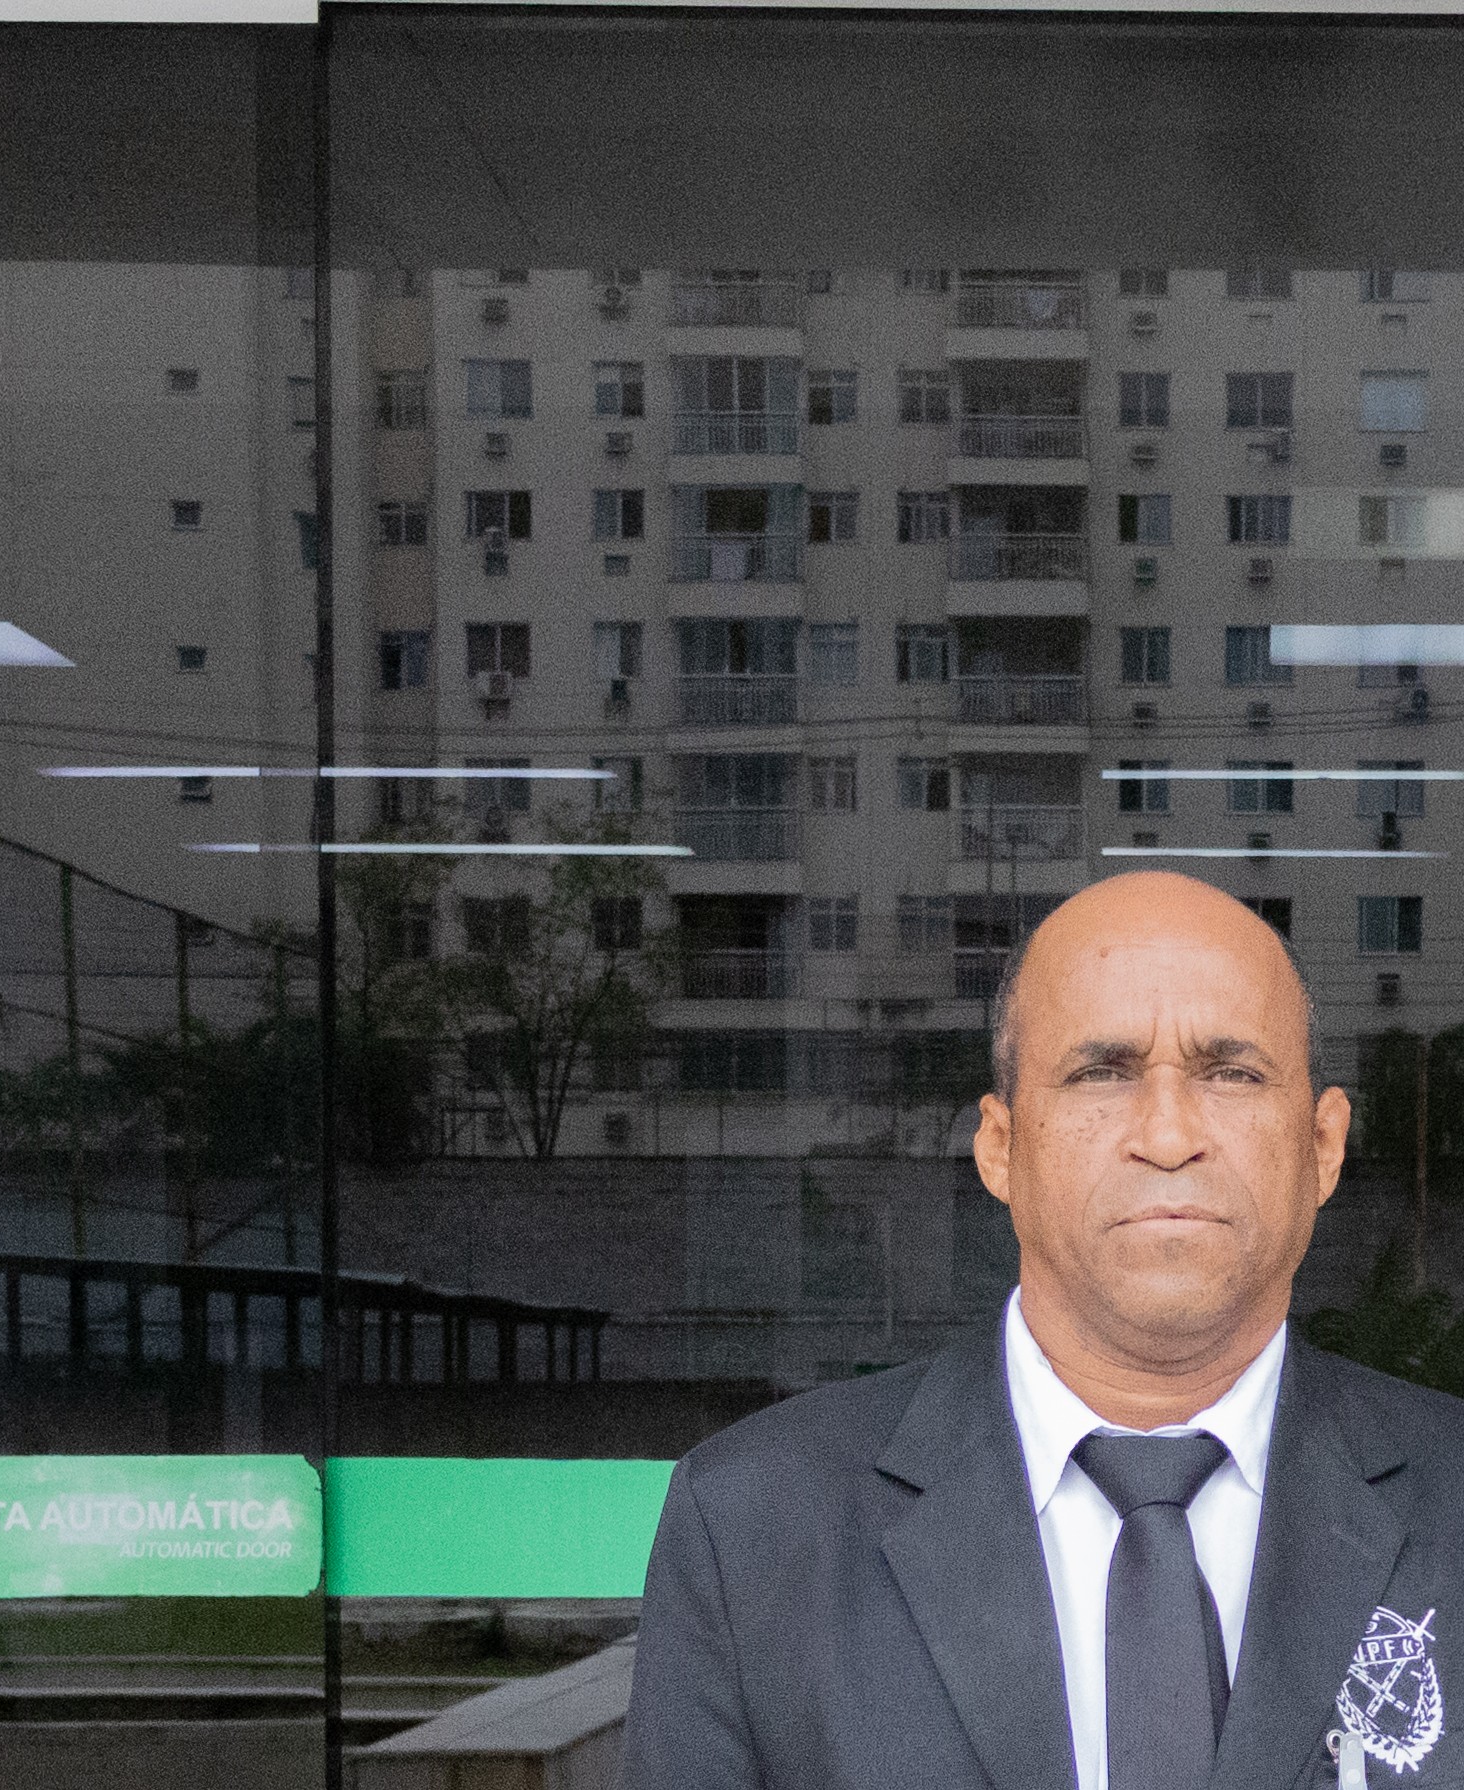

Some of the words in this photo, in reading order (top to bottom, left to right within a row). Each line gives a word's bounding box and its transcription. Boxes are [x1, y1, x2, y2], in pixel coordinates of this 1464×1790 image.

[39, 1493, 294, 1532] AUTOMÁTICA
[119, 1540, 231, 1559] AUTOMATIC
[236, 1540, 292, 1559] DOOR
[1353, 1638, 1397, 1664] JPF
